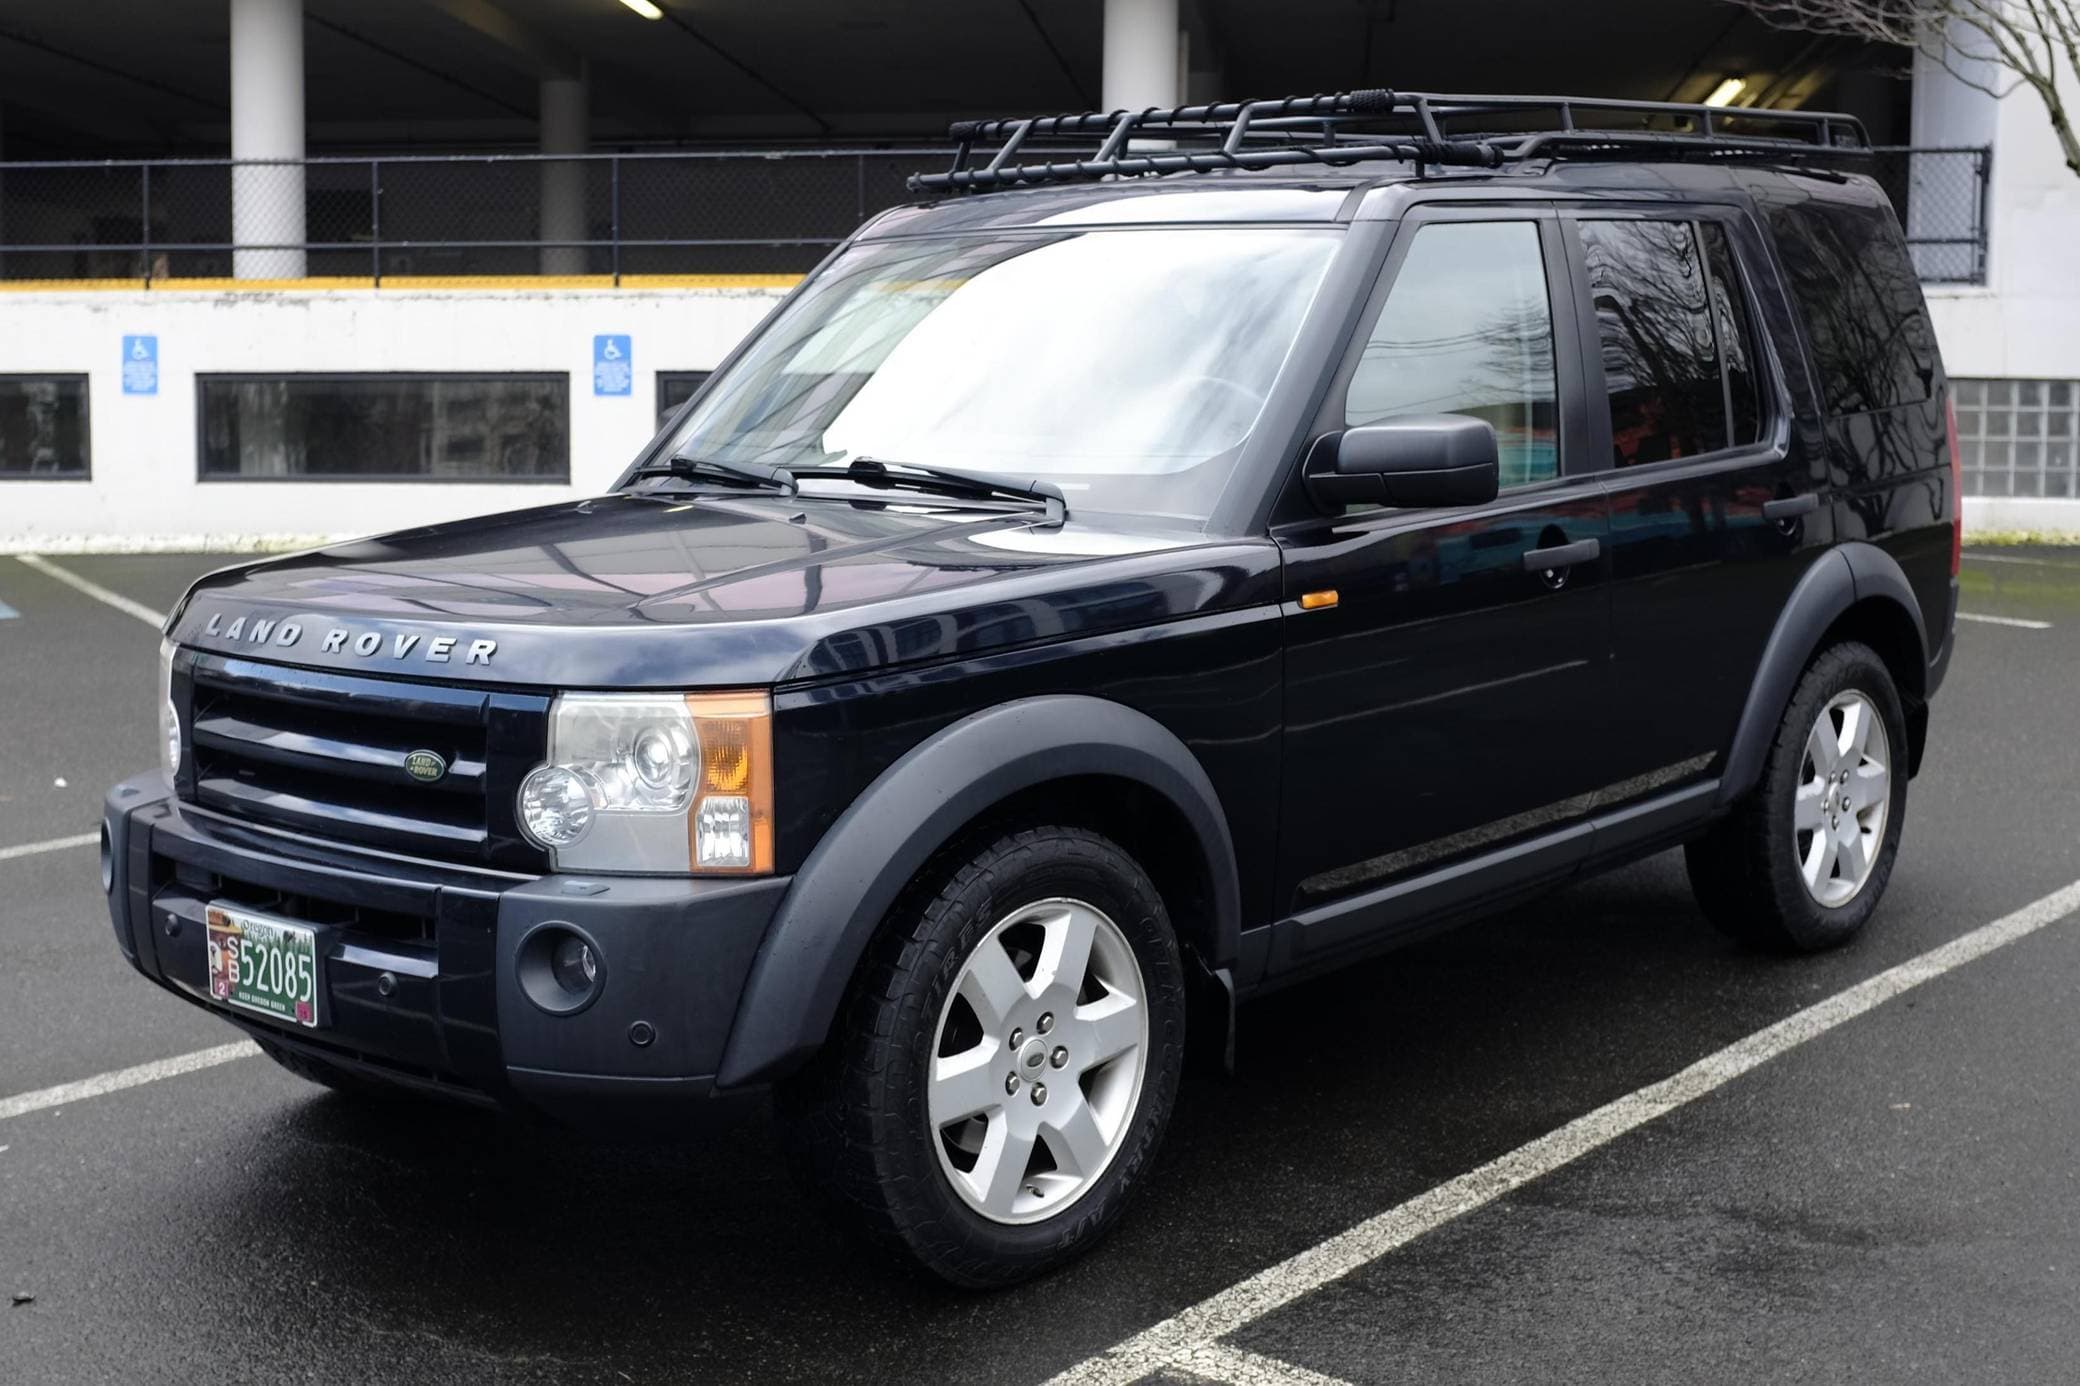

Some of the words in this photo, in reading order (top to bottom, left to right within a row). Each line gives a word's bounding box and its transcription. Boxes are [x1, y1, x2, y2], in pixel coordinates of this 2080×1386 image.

[204, 612, 303, 647] LAND
[321, 628, 498, 666] ROVER
[411, 756, 432, 767] LAND
[413, 765, 438, 776] ROVER
[240, 938, 312, 1002] 52085
